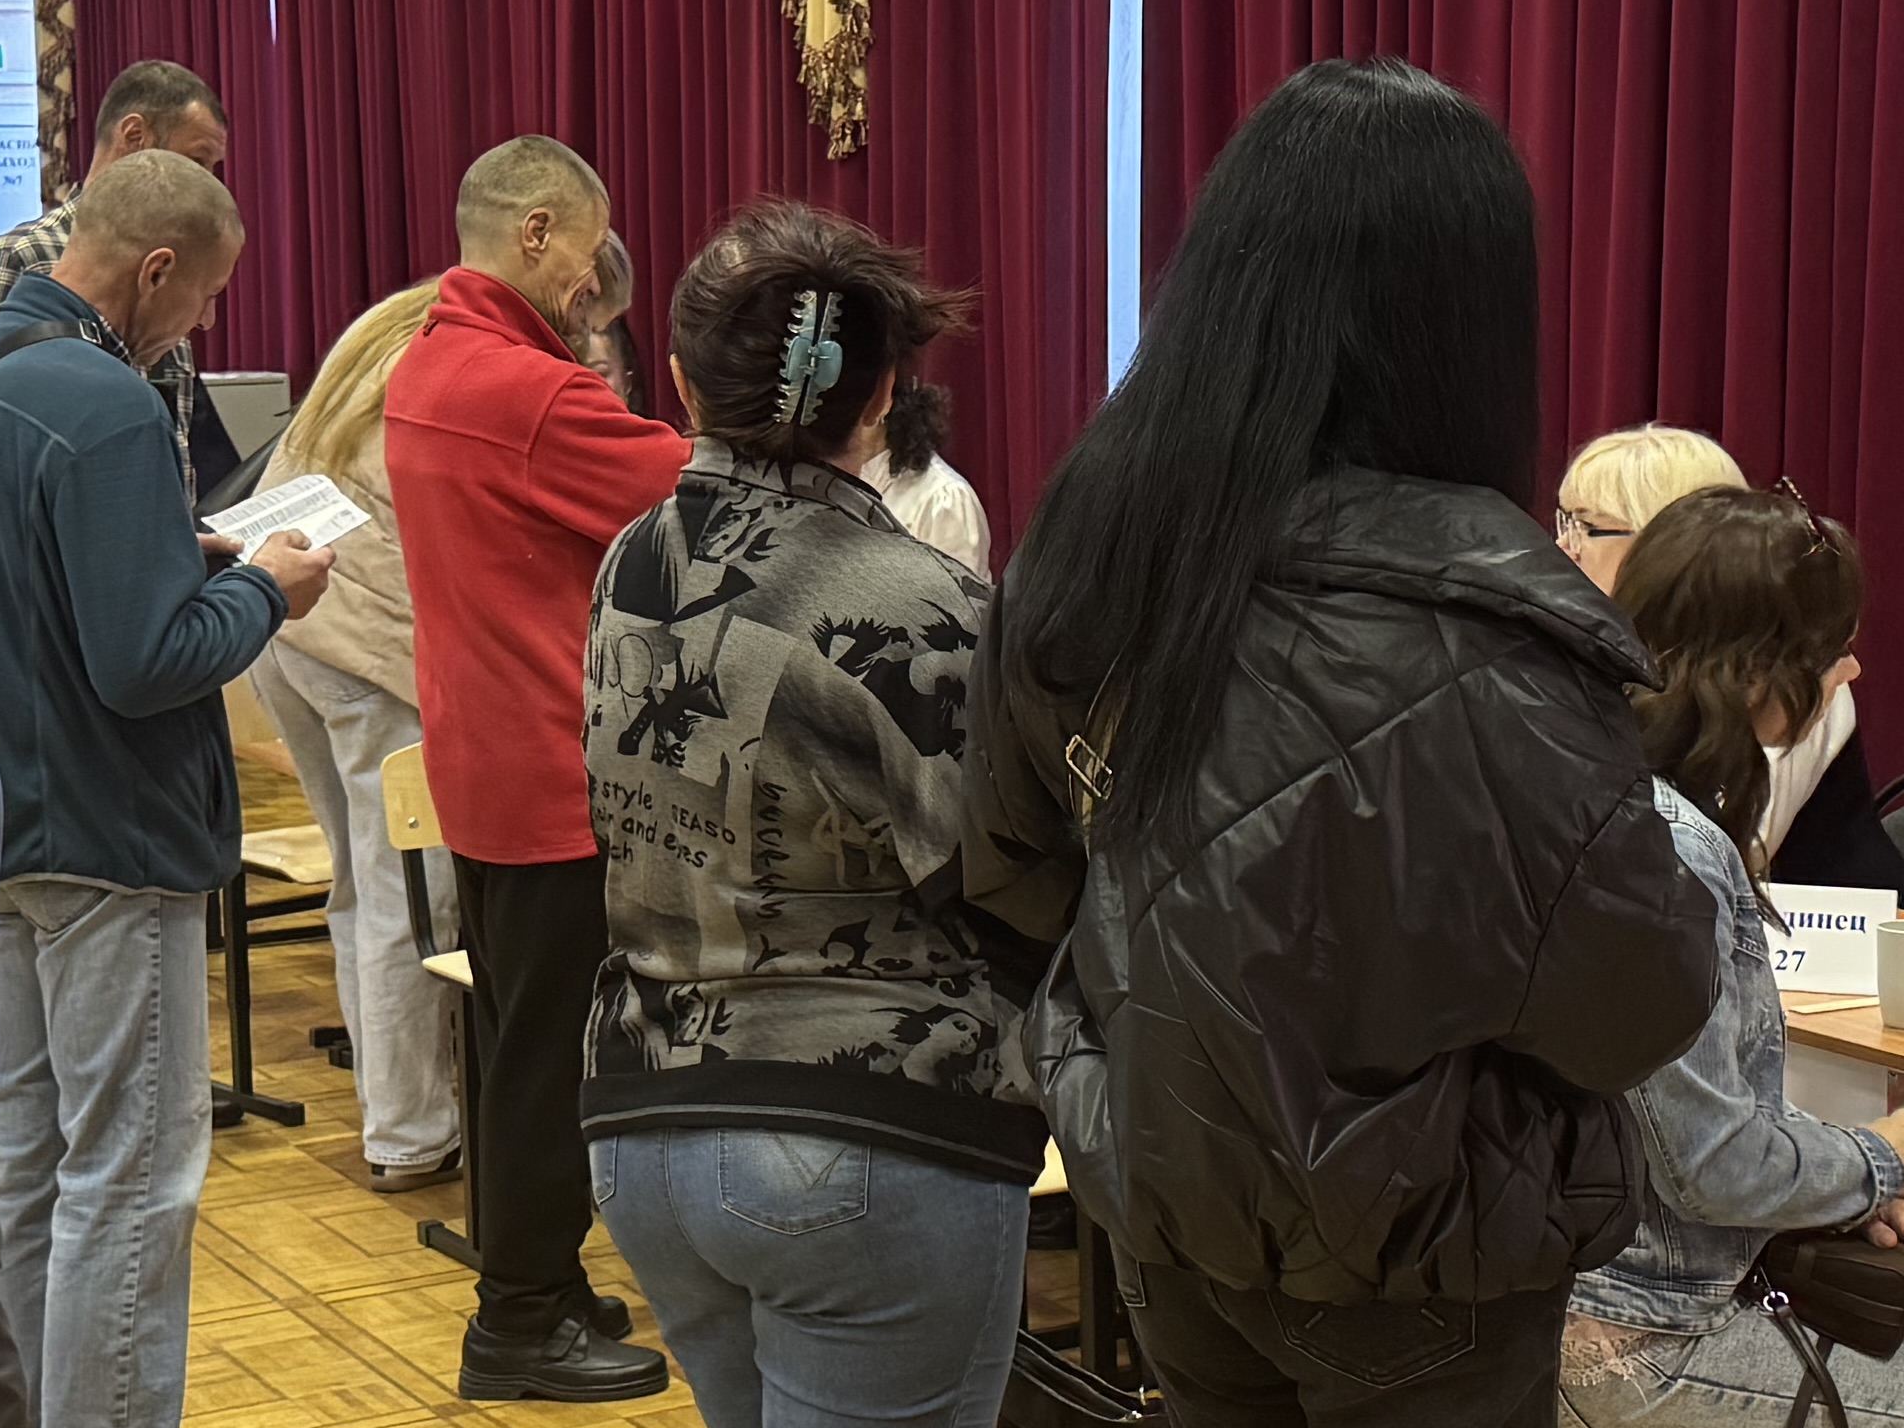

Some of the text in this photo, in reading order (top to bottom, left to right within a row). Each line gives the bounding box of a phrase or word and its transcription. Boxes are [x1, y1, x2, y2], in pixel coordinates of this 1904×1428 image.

[601, 780, 653, 811] style
[621, 818, 658, 844] and
[1783, 911, 1866, 934] динец
[1774, 949, 1806, 973] 27
